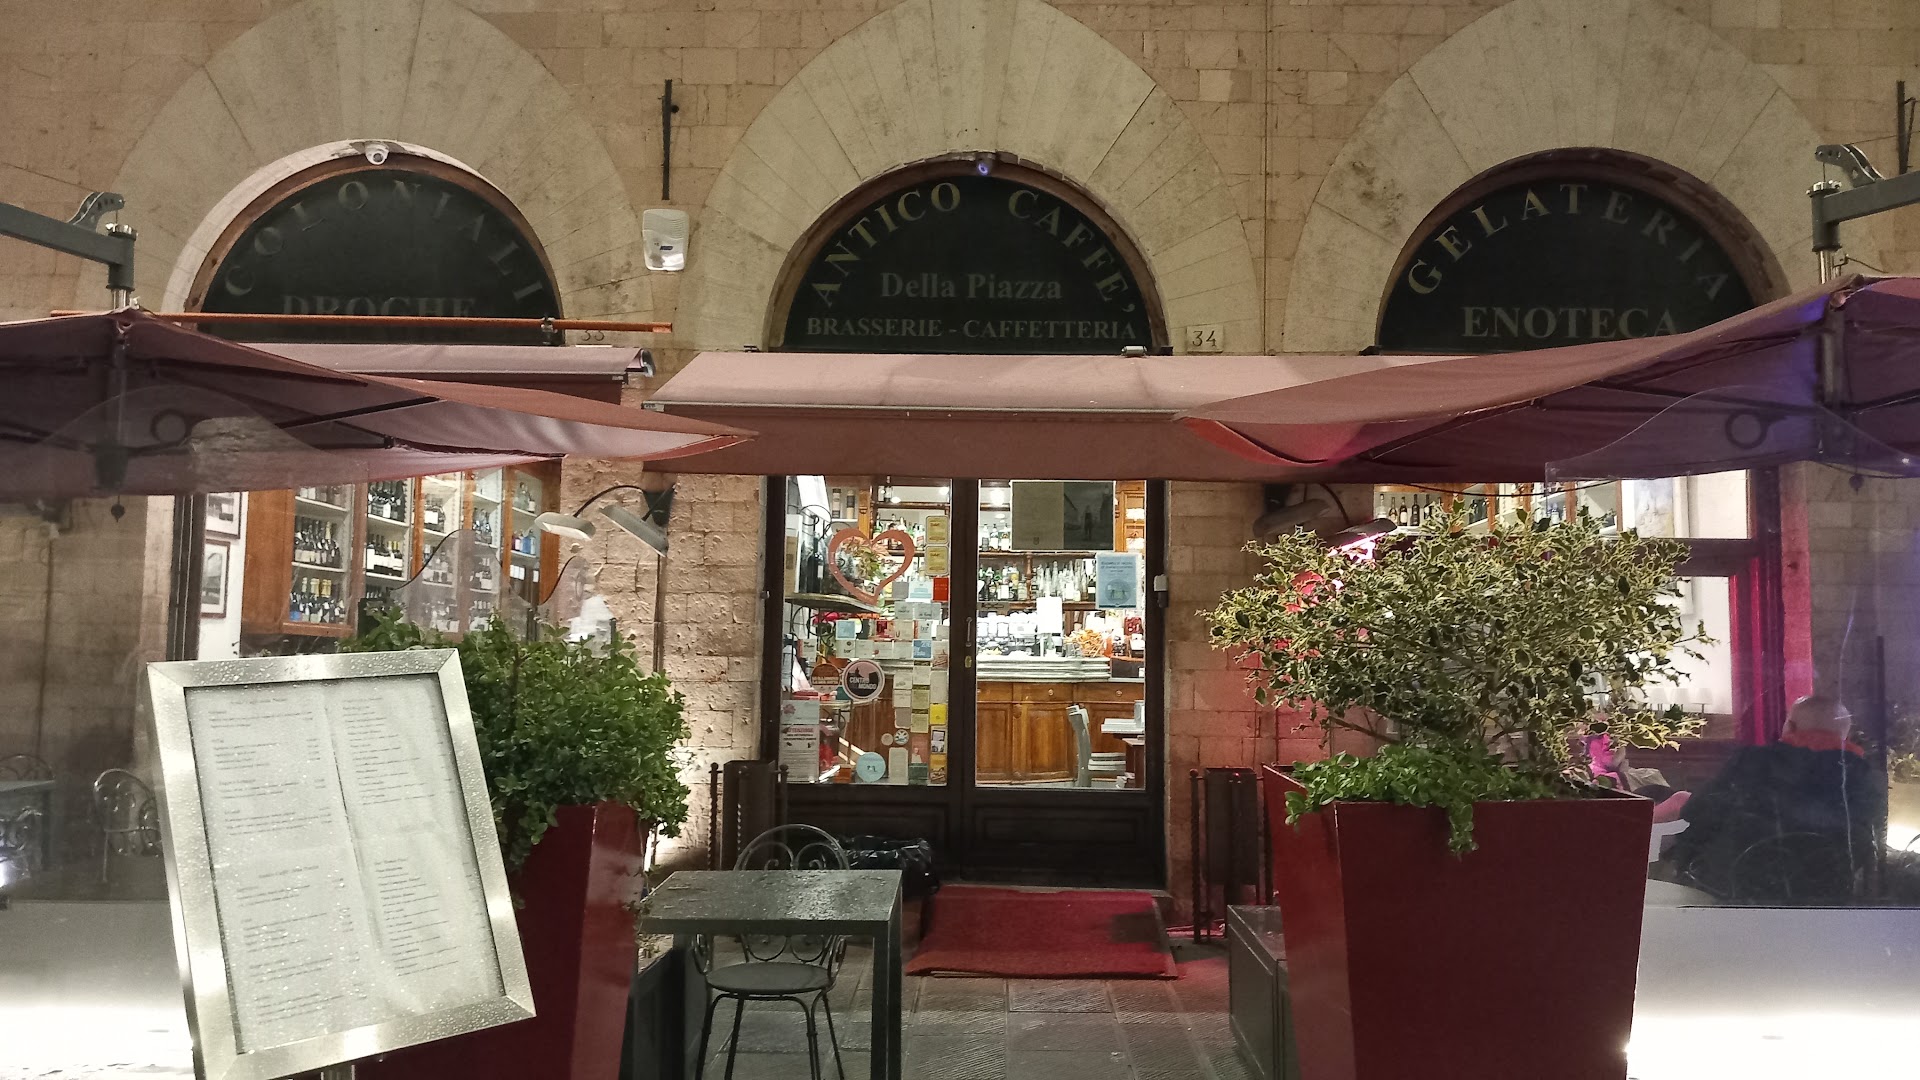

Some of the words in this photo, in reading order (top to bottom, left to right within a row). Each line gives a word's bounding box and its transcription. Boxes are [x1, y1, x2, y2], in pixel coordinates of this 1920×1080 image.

[225, 179, 543, 302] COLONIALI
[811, 181, 961, 308] ANTICO
[1407, 183, 1729, 300] GELATERIA
[880, 272, 956, 299] Della
[967, 272, 1063, 300] Piazza
[806, 317, 942, 337] BRASSERIE
[962, 318, 1137, 340] CAFFETTERIA
[1191, 330, 1217, 348] 34
[1461, 305, 1680, 339] ENOTECA
